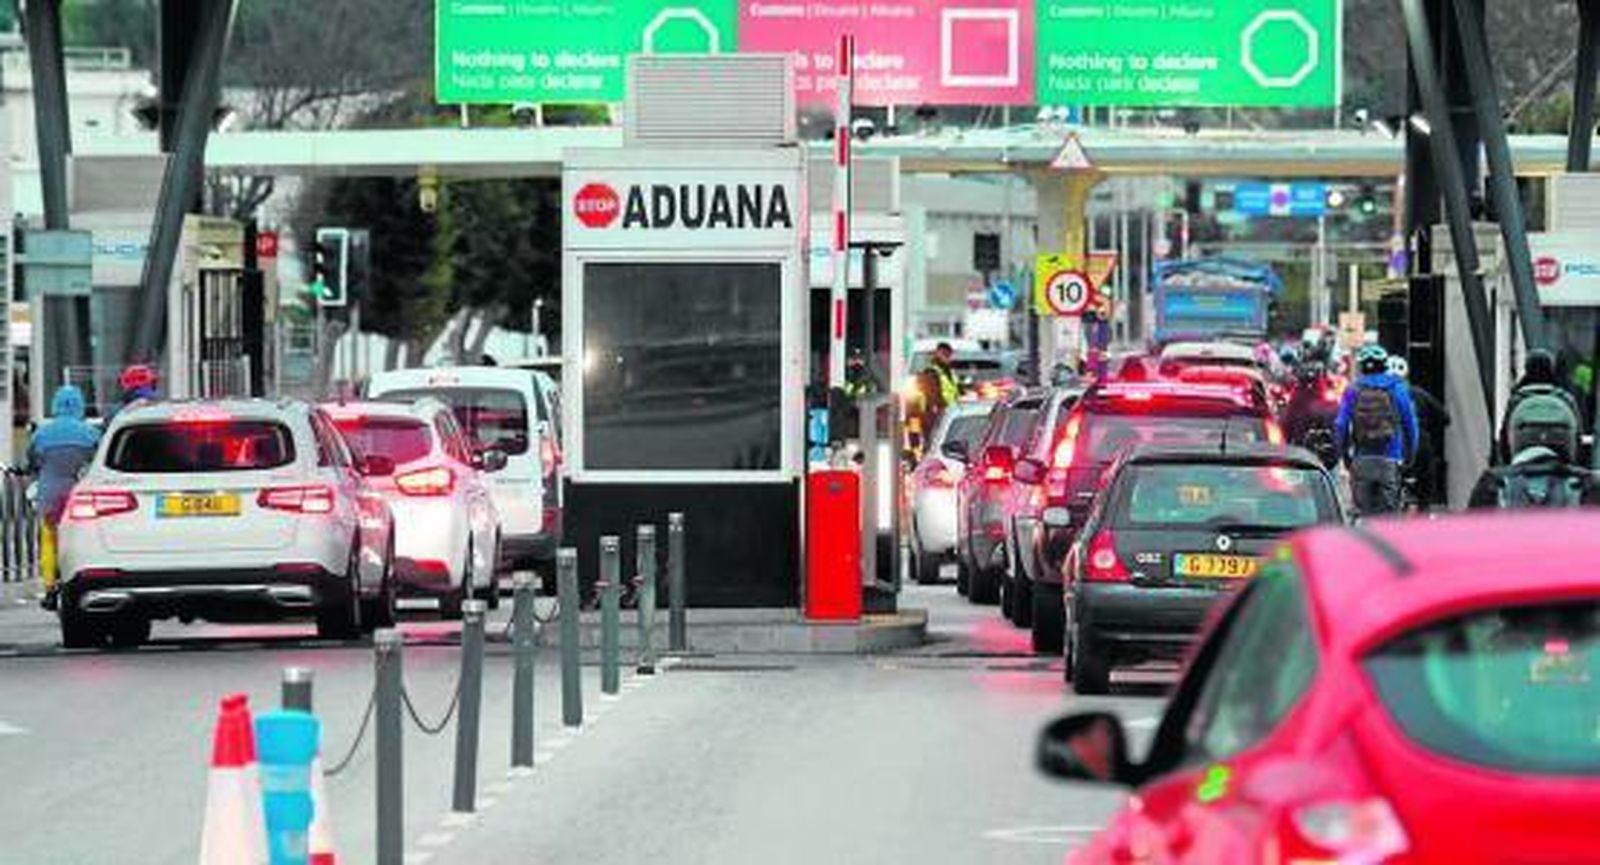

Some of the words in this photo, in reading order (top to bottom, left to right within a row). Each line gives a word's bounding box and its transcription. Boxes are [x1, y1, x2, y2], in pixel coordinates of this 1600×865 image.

[452, 49, 526, 73] Nothing
[530, 50, 550, 69] to
[553, 49, 621, 69] declare
[1049, 53, 1123, 74] Nothing
[1129, 55, 1148, 71] to
[1151, 53, 1219, 71] declare
[576, 198, 616, 213] STOP
[622, 184, 793, 230] ADUANA
[1055, 281, 1082, 304] 10
